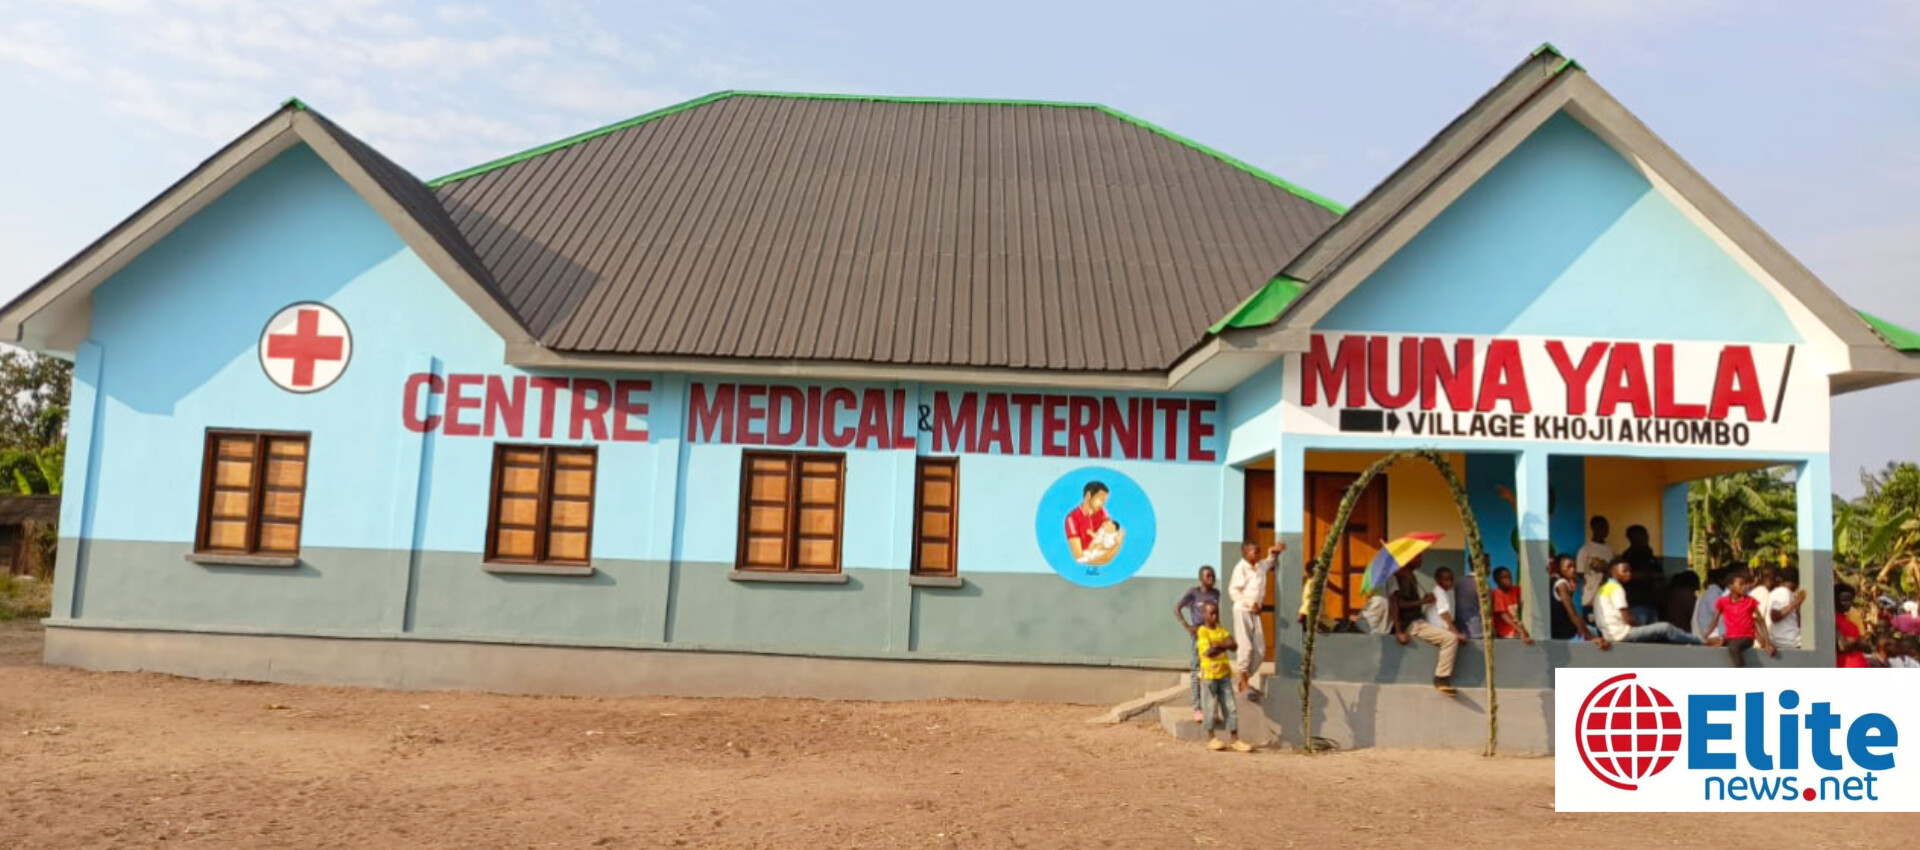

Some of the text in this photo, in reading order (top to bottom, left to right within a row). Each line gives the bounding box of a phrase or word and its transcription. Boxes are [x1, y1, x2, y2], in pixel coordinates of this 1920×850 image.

[402, 372, 651, 441] CENTRE
[687, 381, 916, 449] MEDICAL
[932, 391, 1216, 461] MATERNITE
[1301, 334, 1532, 412] MUNA
[1545, 340, 1767, 421] YALA
[1406, 411, 1525, 438] VILLAGE
